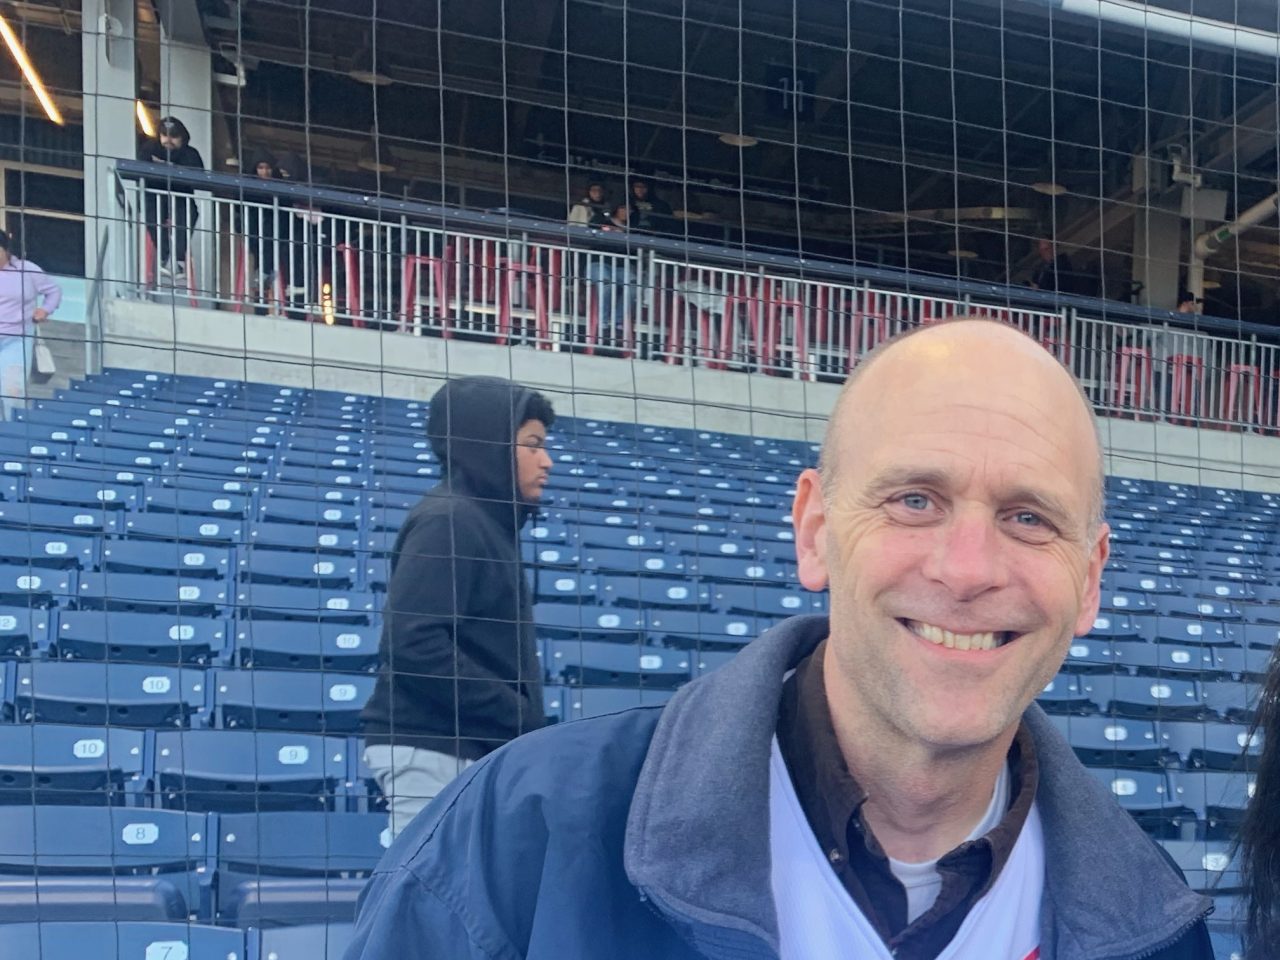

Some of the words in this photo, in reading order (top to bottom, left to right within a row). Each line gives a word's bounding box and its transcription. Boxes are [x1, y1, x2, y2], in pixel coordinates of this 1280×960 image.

[149, 679, 164, 691] 10
[338, 687, 348, 698] 9
[82, 742, 98, 754] 10
[289, 748, 299, 760] 9
[134, 826, 145, 840] 8
[160, 945, 173, 960] 7
